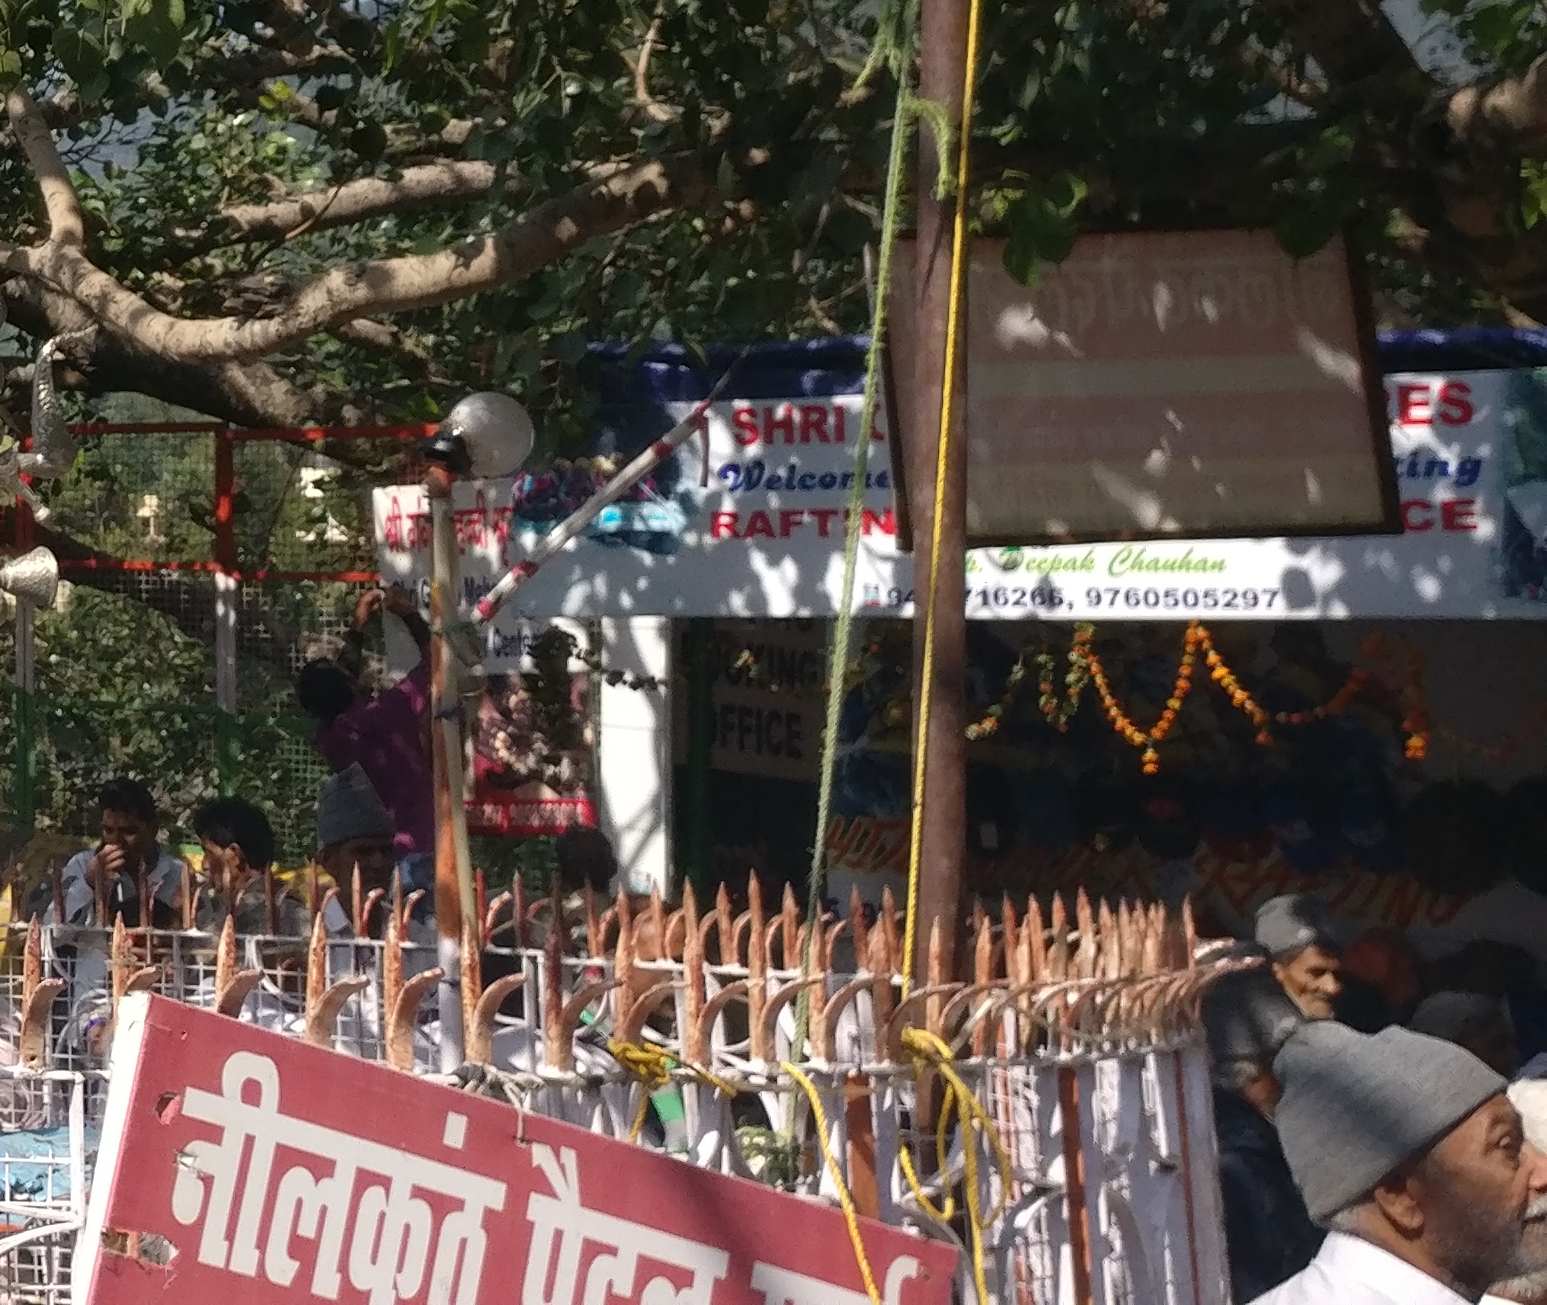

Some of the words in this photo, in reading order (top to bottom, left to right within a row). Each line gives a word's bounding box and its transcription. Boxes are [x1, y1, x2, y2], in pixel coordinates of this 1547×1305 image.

[732, 403, 846, 446] SHRI
[710, 507, 896, 539] RAFTIN
[1107, 546, 1227, 578] Chauhan
[1085, 586, 1281, 609] 9760505297
[720, 705, 804, 760] FFICE
[171, 1050, 507, 1303] नीलकंठ
